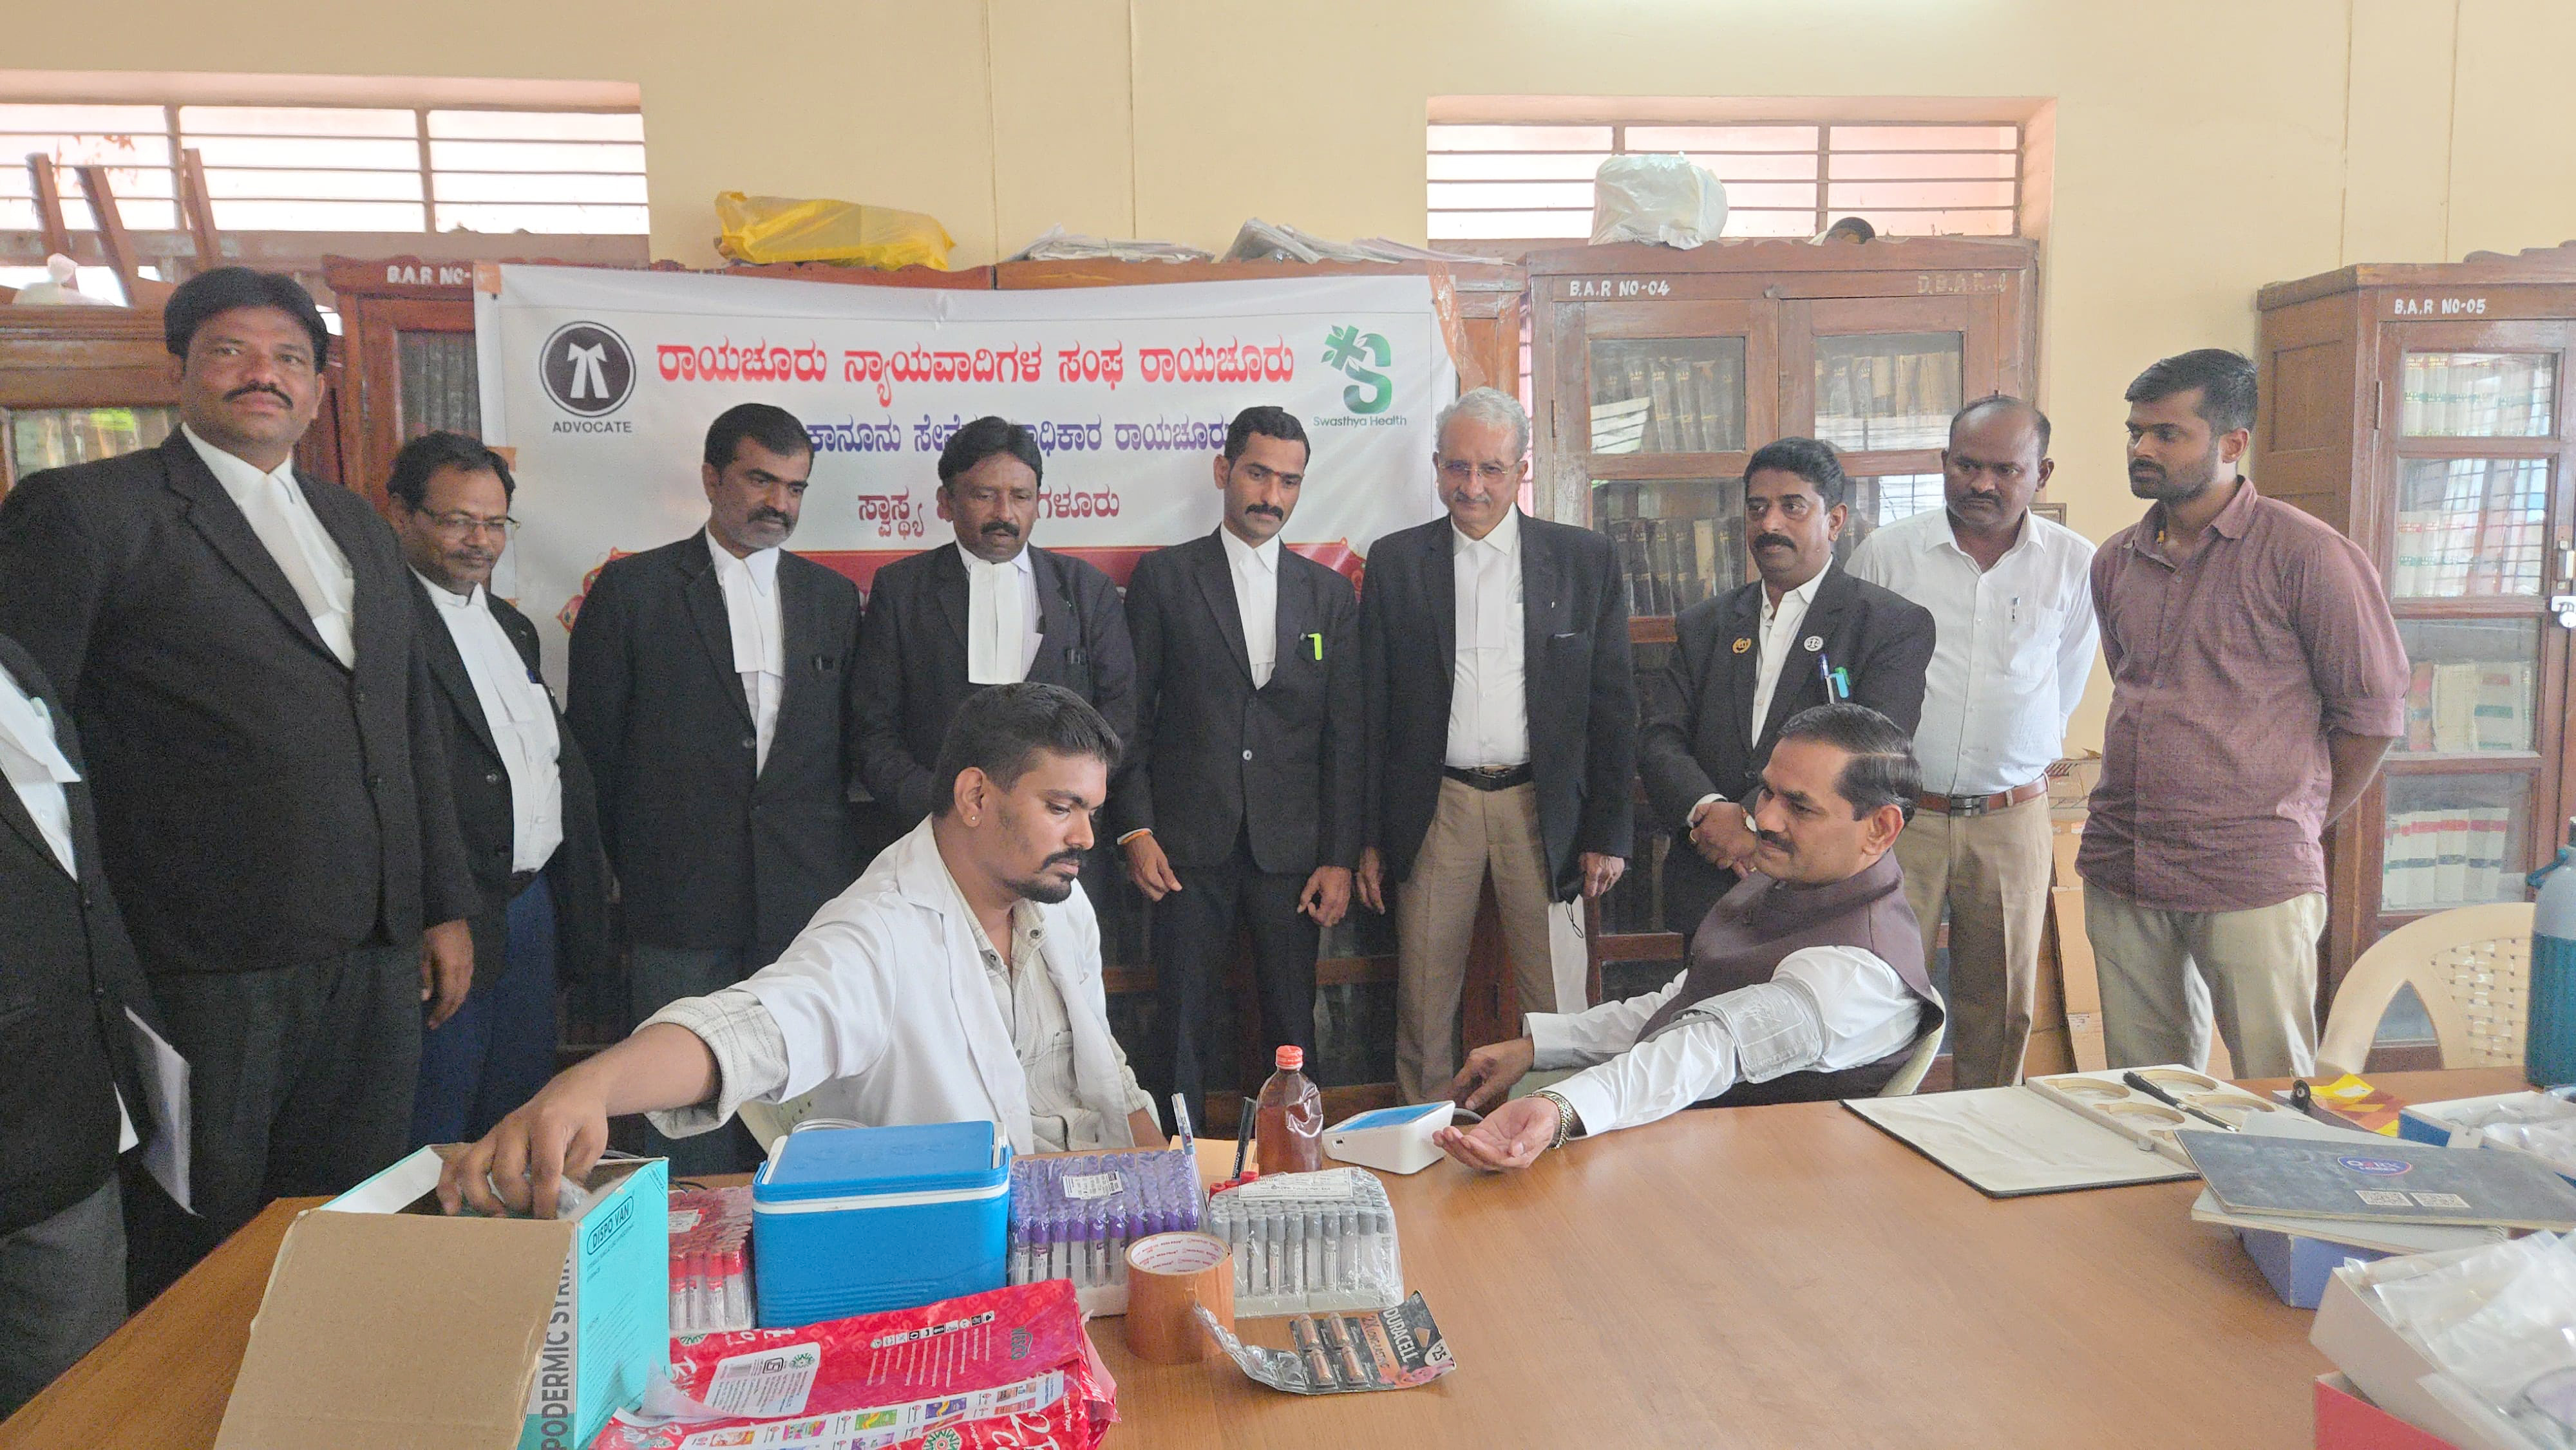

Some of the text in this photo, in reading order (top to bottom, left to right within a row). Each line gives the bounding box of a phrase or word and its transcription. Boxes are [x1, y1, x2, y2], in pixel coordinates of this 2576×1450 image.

[1569, 279, 1670, 297] B.A.R NO-04
[2441, 298, 2486, 314] NO-05
[657, 334, 1294, 408] ರಾಯಚೂರು ನ್ಯಾಯವಾದಿಗಳ ಸಂಘ ರಾಯಚೂರು
[553, 420, 632, 433] ADVOCATE
[806, 413, 900, 452] ಕಾನೂನು
[1313, 415, 1407, 428] Swasthya Health
[1037, 484, 1119, 518] ಗಳೂರು
[592, 1218, 613, 1248] DISPO
[615, 1203, 629, 1227] VAN
[1383, 1307, 1419, 1362] DURACELL
